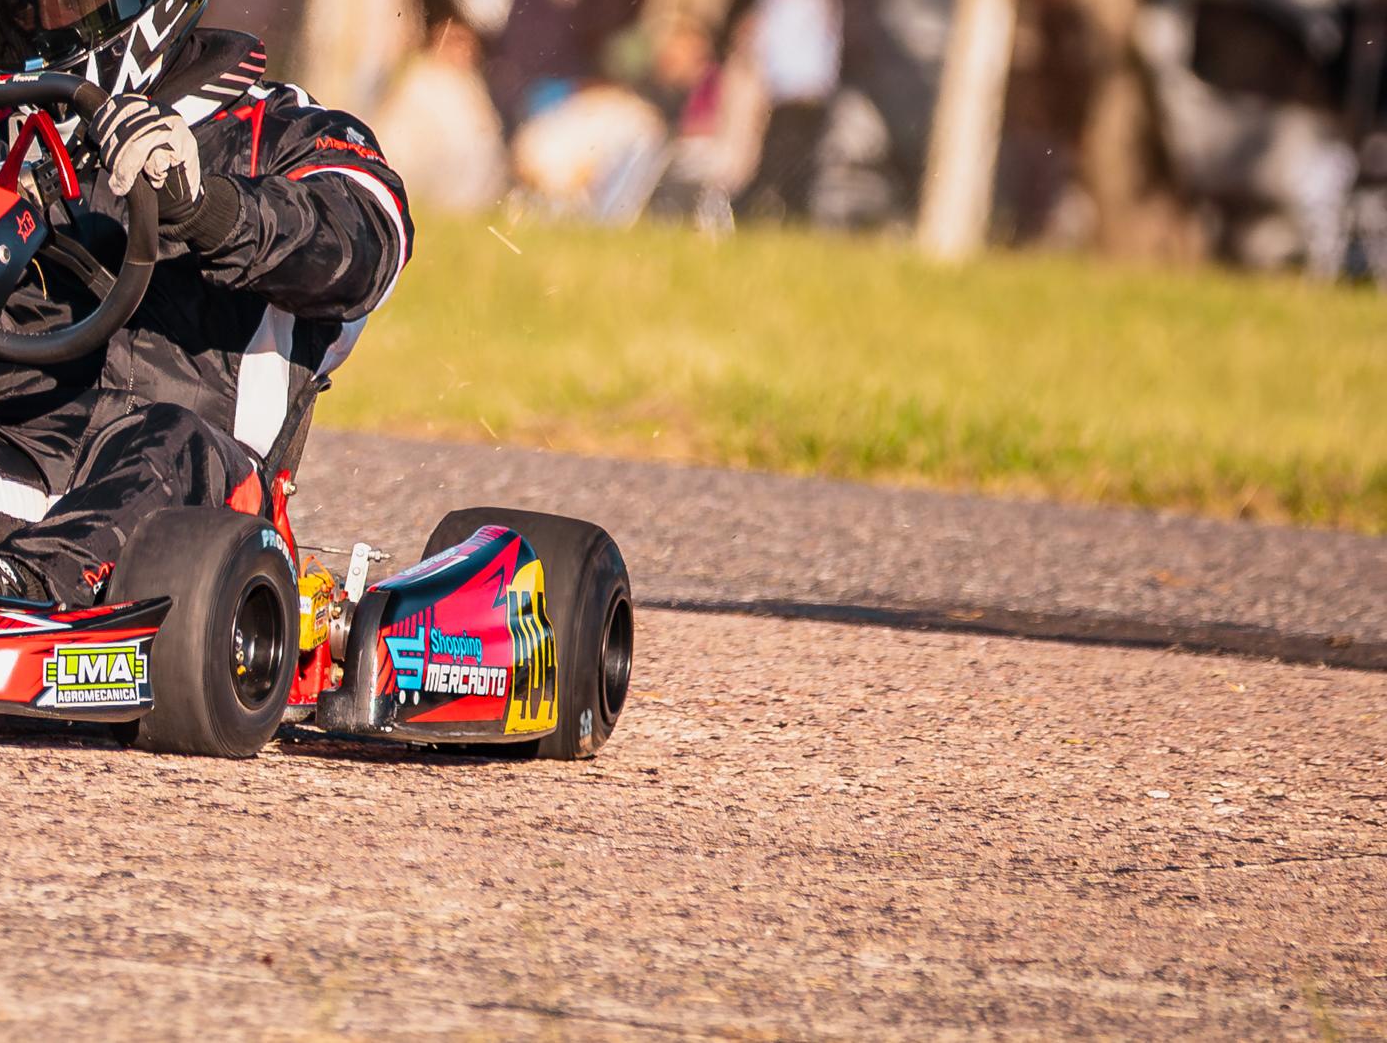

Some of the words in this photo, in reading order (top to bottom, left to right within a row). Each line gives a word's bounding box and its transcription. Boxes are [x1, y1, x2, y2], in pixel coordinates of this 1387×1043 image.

[431, 628, 483, 664] Shopping
[58, 653, 133, 684] LMA
[425, 664, 508, 697] MERCADITO
[58, 688, 136, 703] AGROMECANICA
